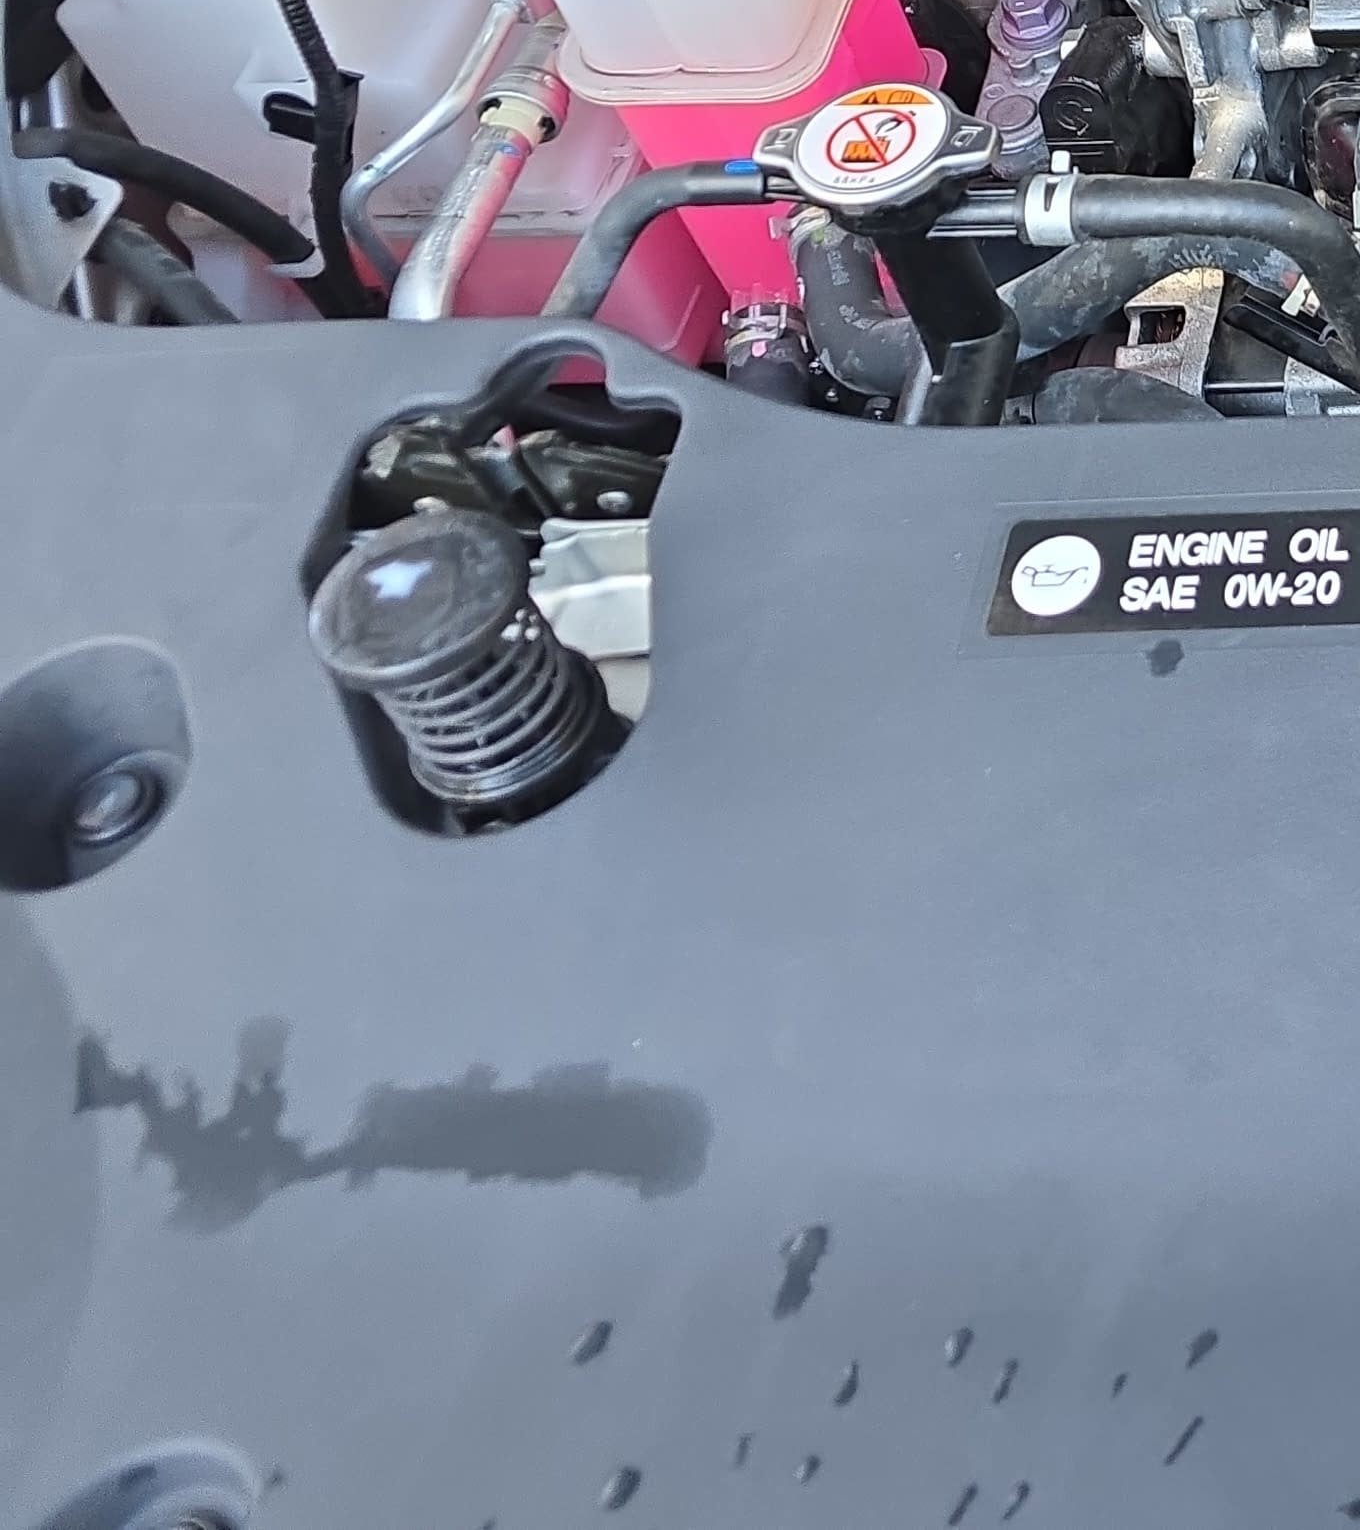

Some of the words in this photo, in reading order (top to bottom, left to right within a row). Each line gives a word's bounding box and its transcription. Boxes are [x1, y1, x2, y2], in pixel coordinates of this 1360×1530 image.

[1128, 530, 1267, 568] ENGINE
[1289, 527, 1350, 563] OIL
[1119, 575, 1200, 612] SAE
[1224, 571, 1340, 607] 0W-20
